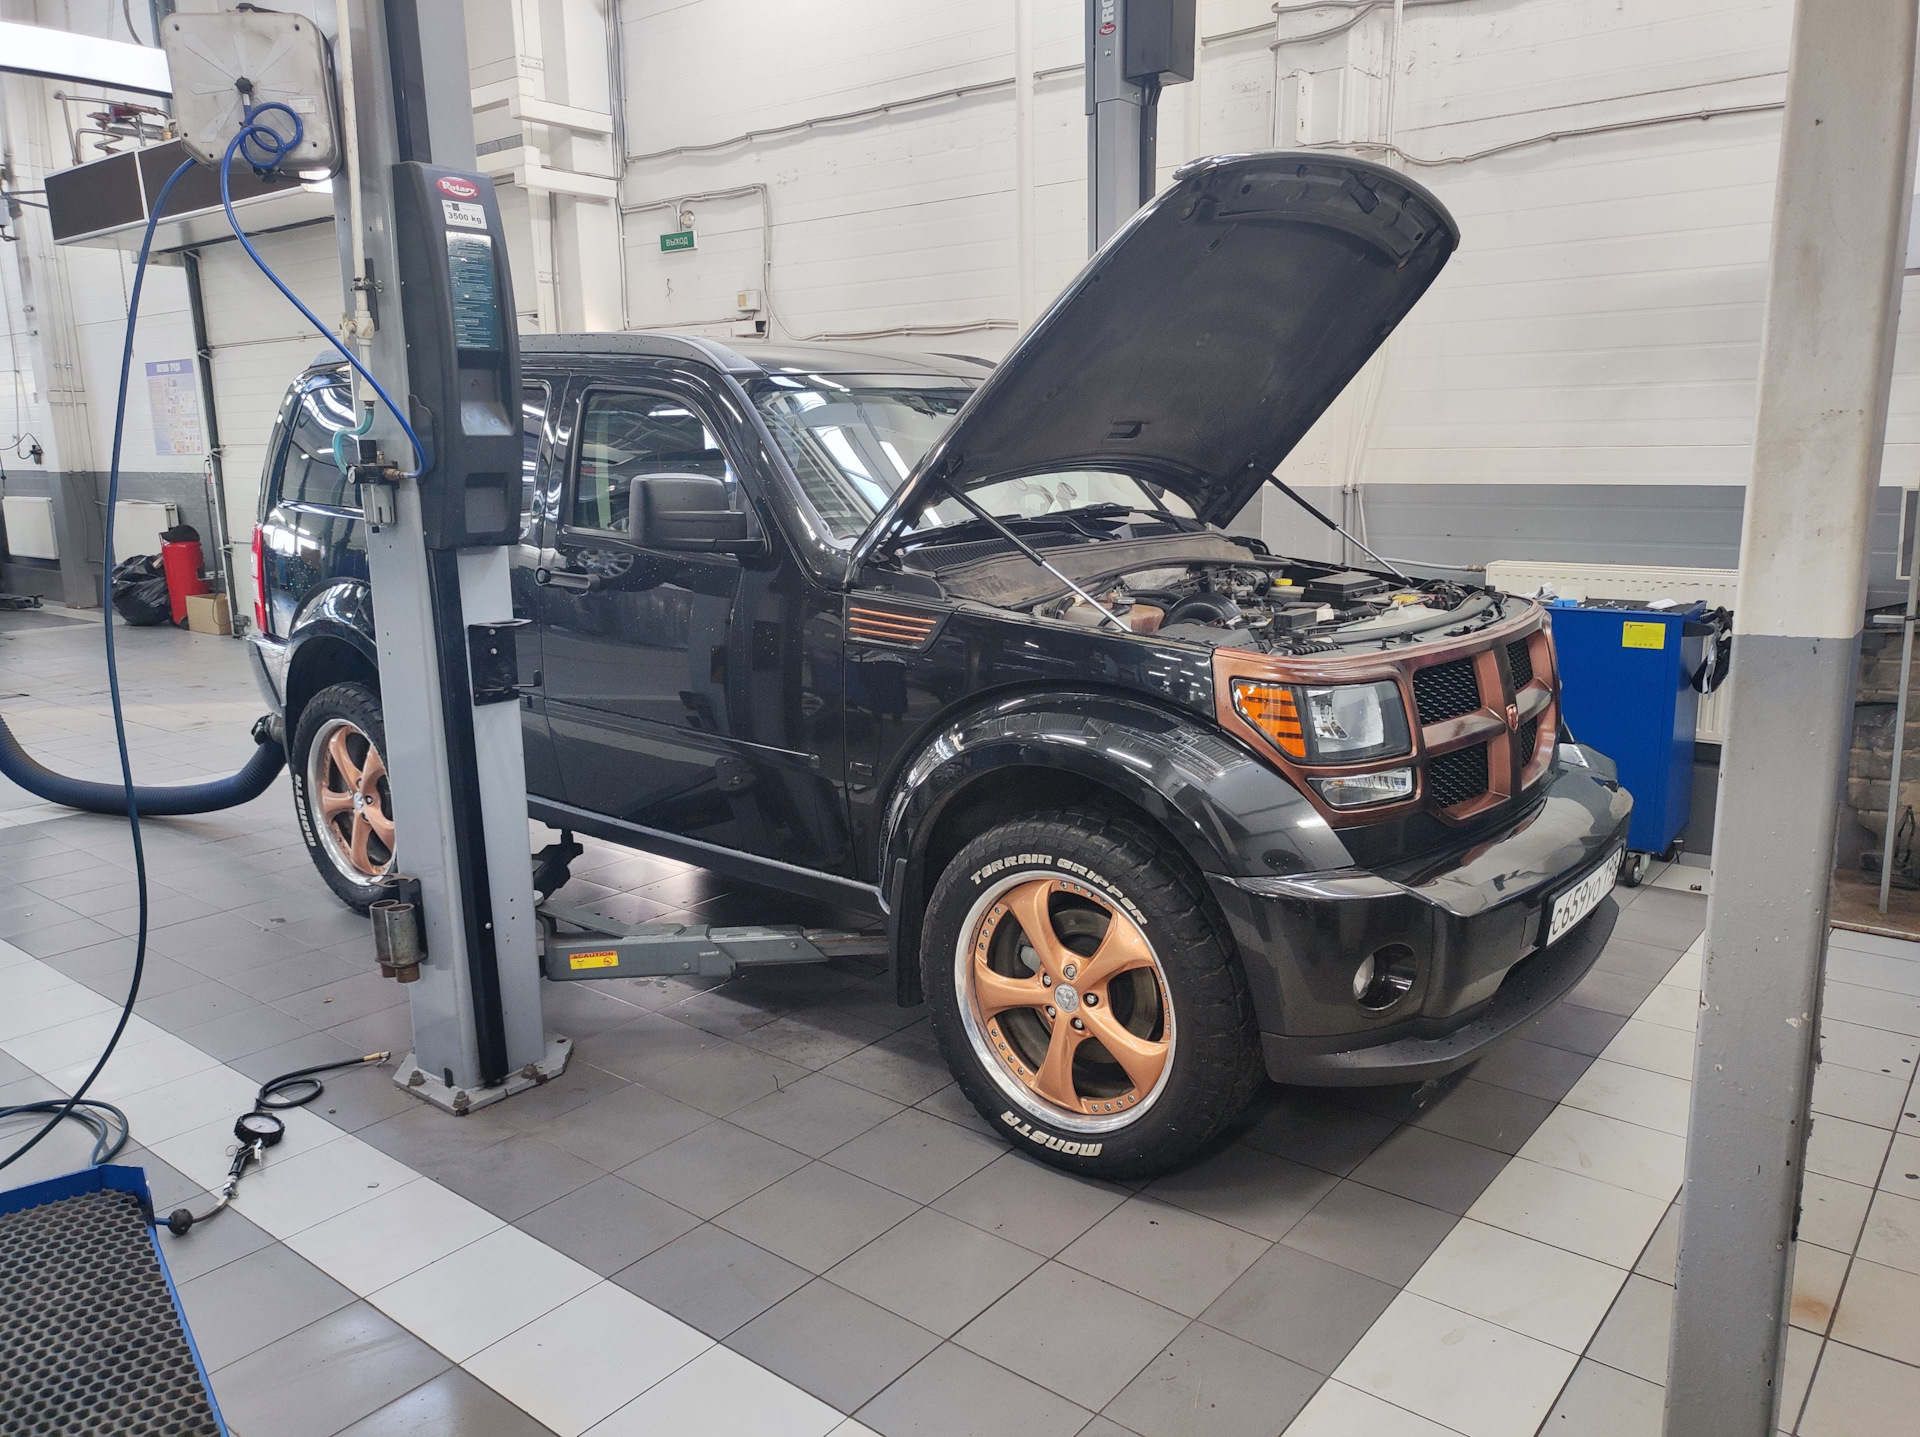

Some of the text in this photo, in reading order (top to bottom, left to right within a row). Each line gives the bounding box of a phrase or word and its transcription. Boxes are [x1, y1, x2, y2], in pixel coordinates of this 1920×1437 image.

[440, 180, 476, 197] Rotary
[448, 212, 482, 224] 3500 kg
[665, 236, 689, 247] ВЫХОД
[970, 853, 1149, 926] TERRAIN GRIPPER
[577, 951, 614, 959] CAUTION
[999, 1111, 1103, 1158] MONSTA
